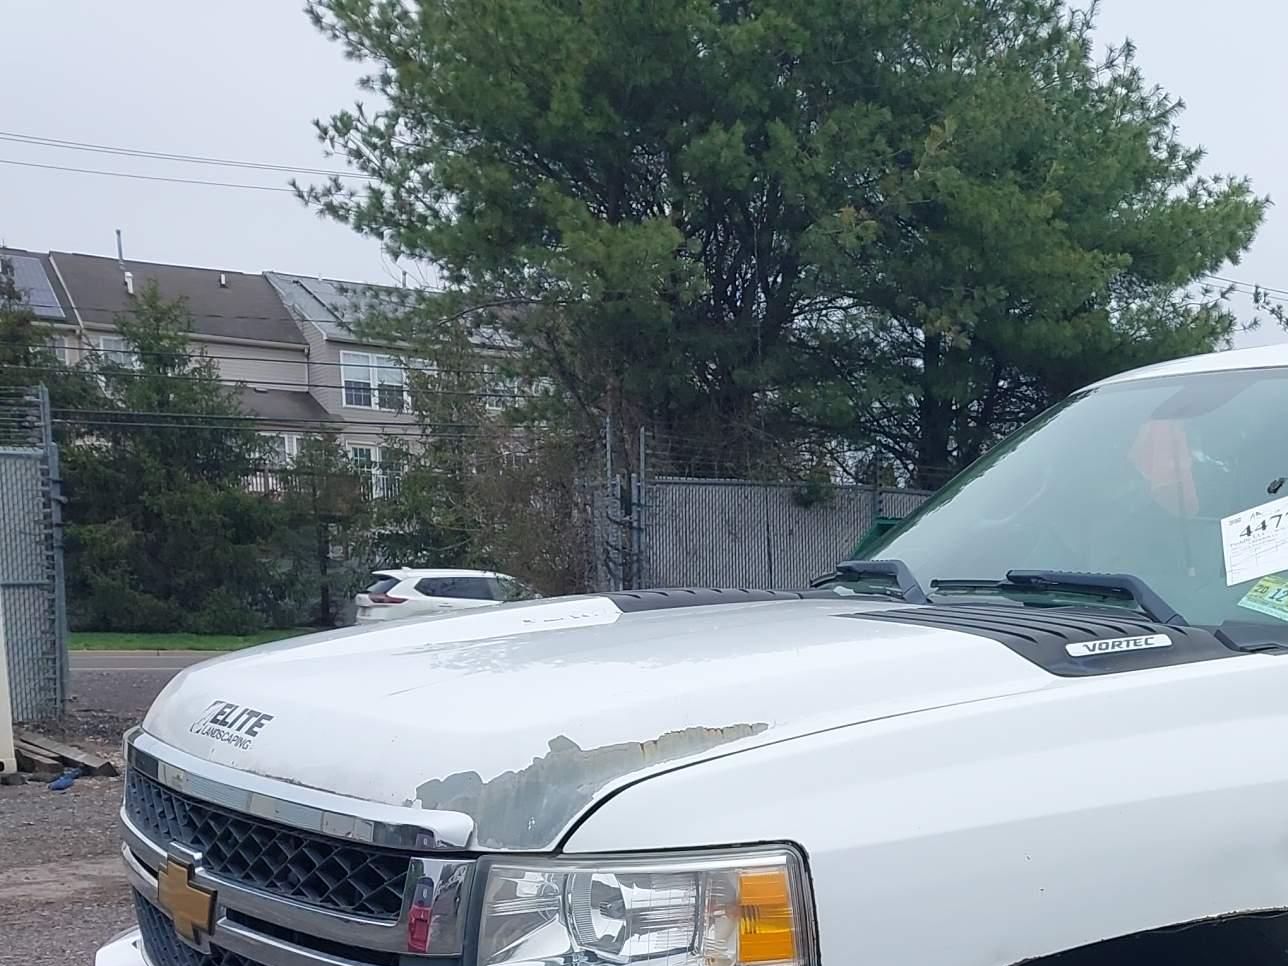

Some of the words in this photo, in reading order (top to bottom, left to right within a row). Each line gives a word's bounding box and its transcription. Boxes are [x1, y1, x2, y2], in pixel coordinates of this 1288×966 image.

[1083, 637, 1155, 652] VORTEC
[210, 703, 274, 738] ELITE
[201, 725, 251, 750] LANDSCAPING
